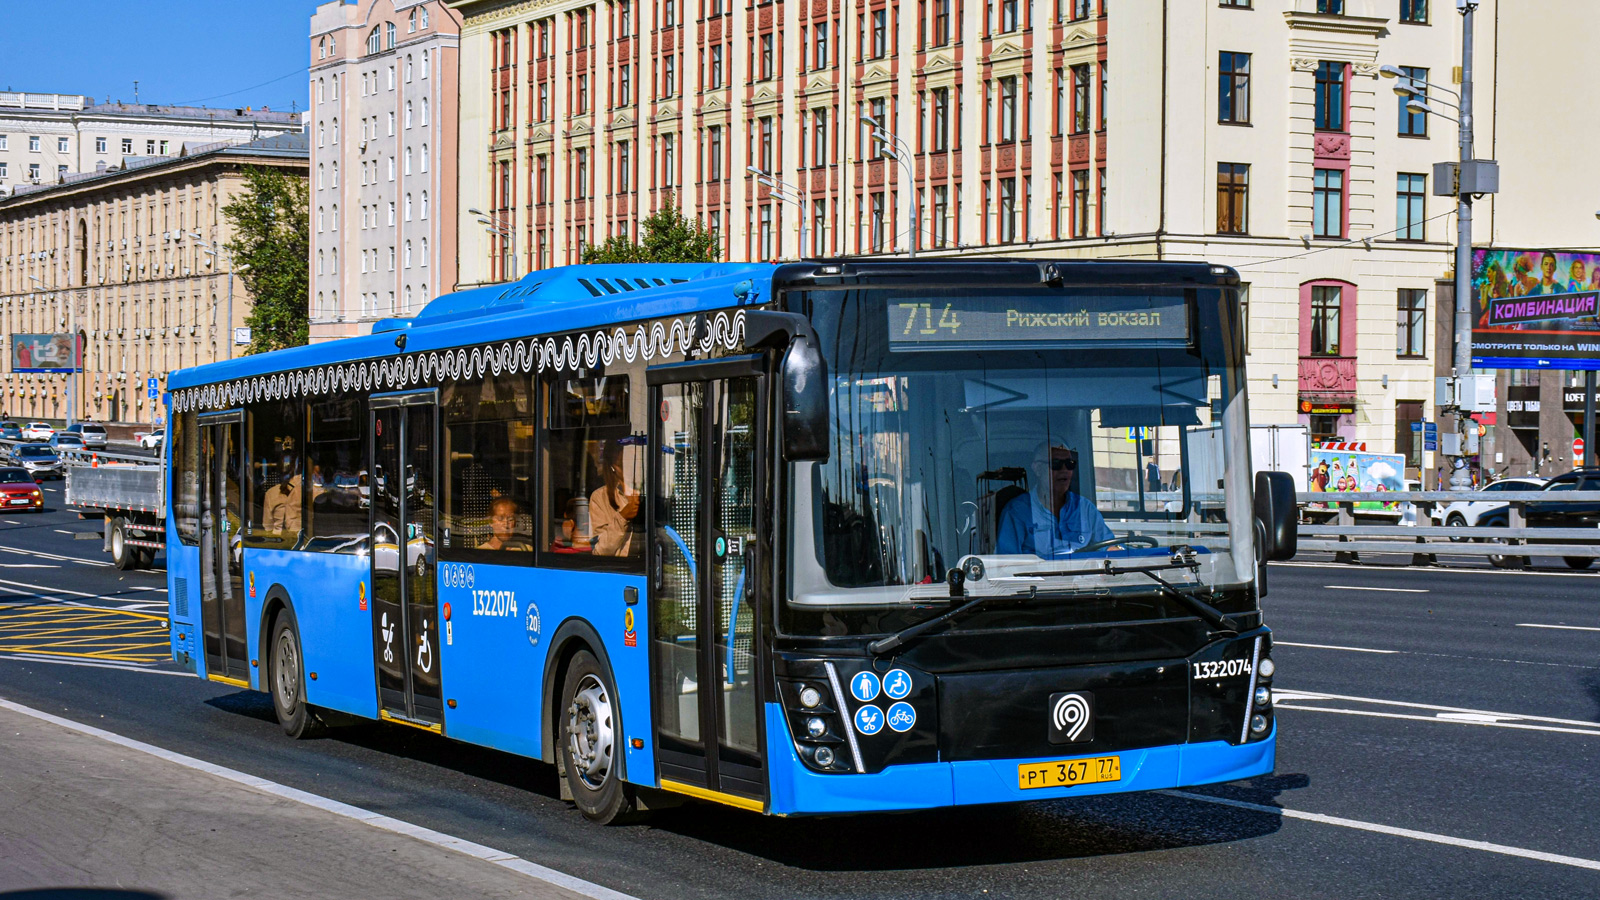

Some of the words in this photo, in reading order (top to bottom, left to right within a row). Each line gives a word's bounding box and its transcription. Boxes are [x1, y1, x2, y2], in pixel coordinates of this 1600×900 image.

[1495, 296, 1595, 319] КОМБИНАЦИЯ
[898, 303, 961, 335] 714
[1006, 309, 1090, 327] Рижский
[1098, 312, 1161, 326] вокзал
[33, 340, 58, 362] t2
[1523, 343, 1561, 351] ТОЛЬКО
[1577, 343, 1600, 352] WIN
[1565, 393, 1586, 402] LOFT
[472, 590, 518, 617] 1322074
[529, 614, 538, 632] 20
[1193, 658, 1252, 680] 1322074
[1056, 762, 1088, 782] 367
[1097, 758, 1114, 773] 77
